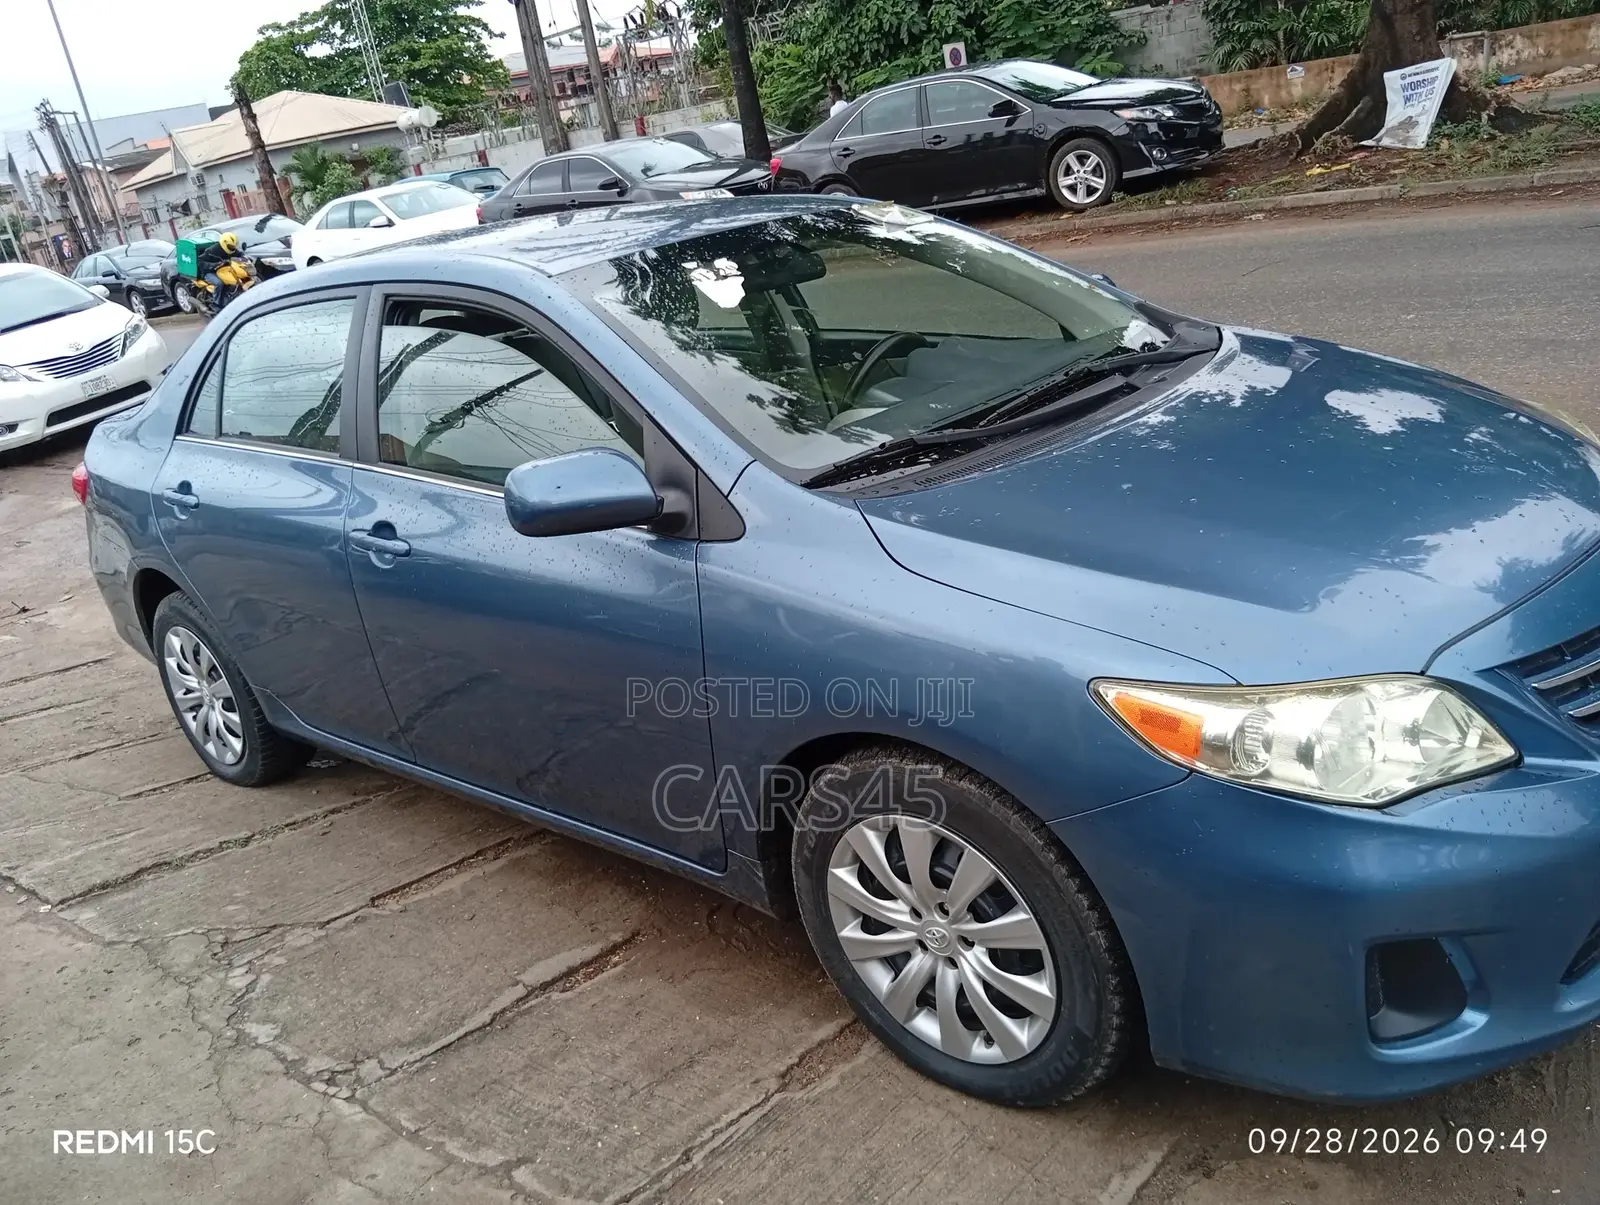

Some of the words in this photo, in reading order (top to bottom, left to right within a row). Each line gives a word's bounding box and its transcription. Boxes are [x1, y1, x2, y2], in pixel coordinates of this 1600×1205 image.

[1400, 76, 1439, 93] WORSHIP
[1402, 90, 1425, 105] WITH
[1425, 87, 1436, 98] US
